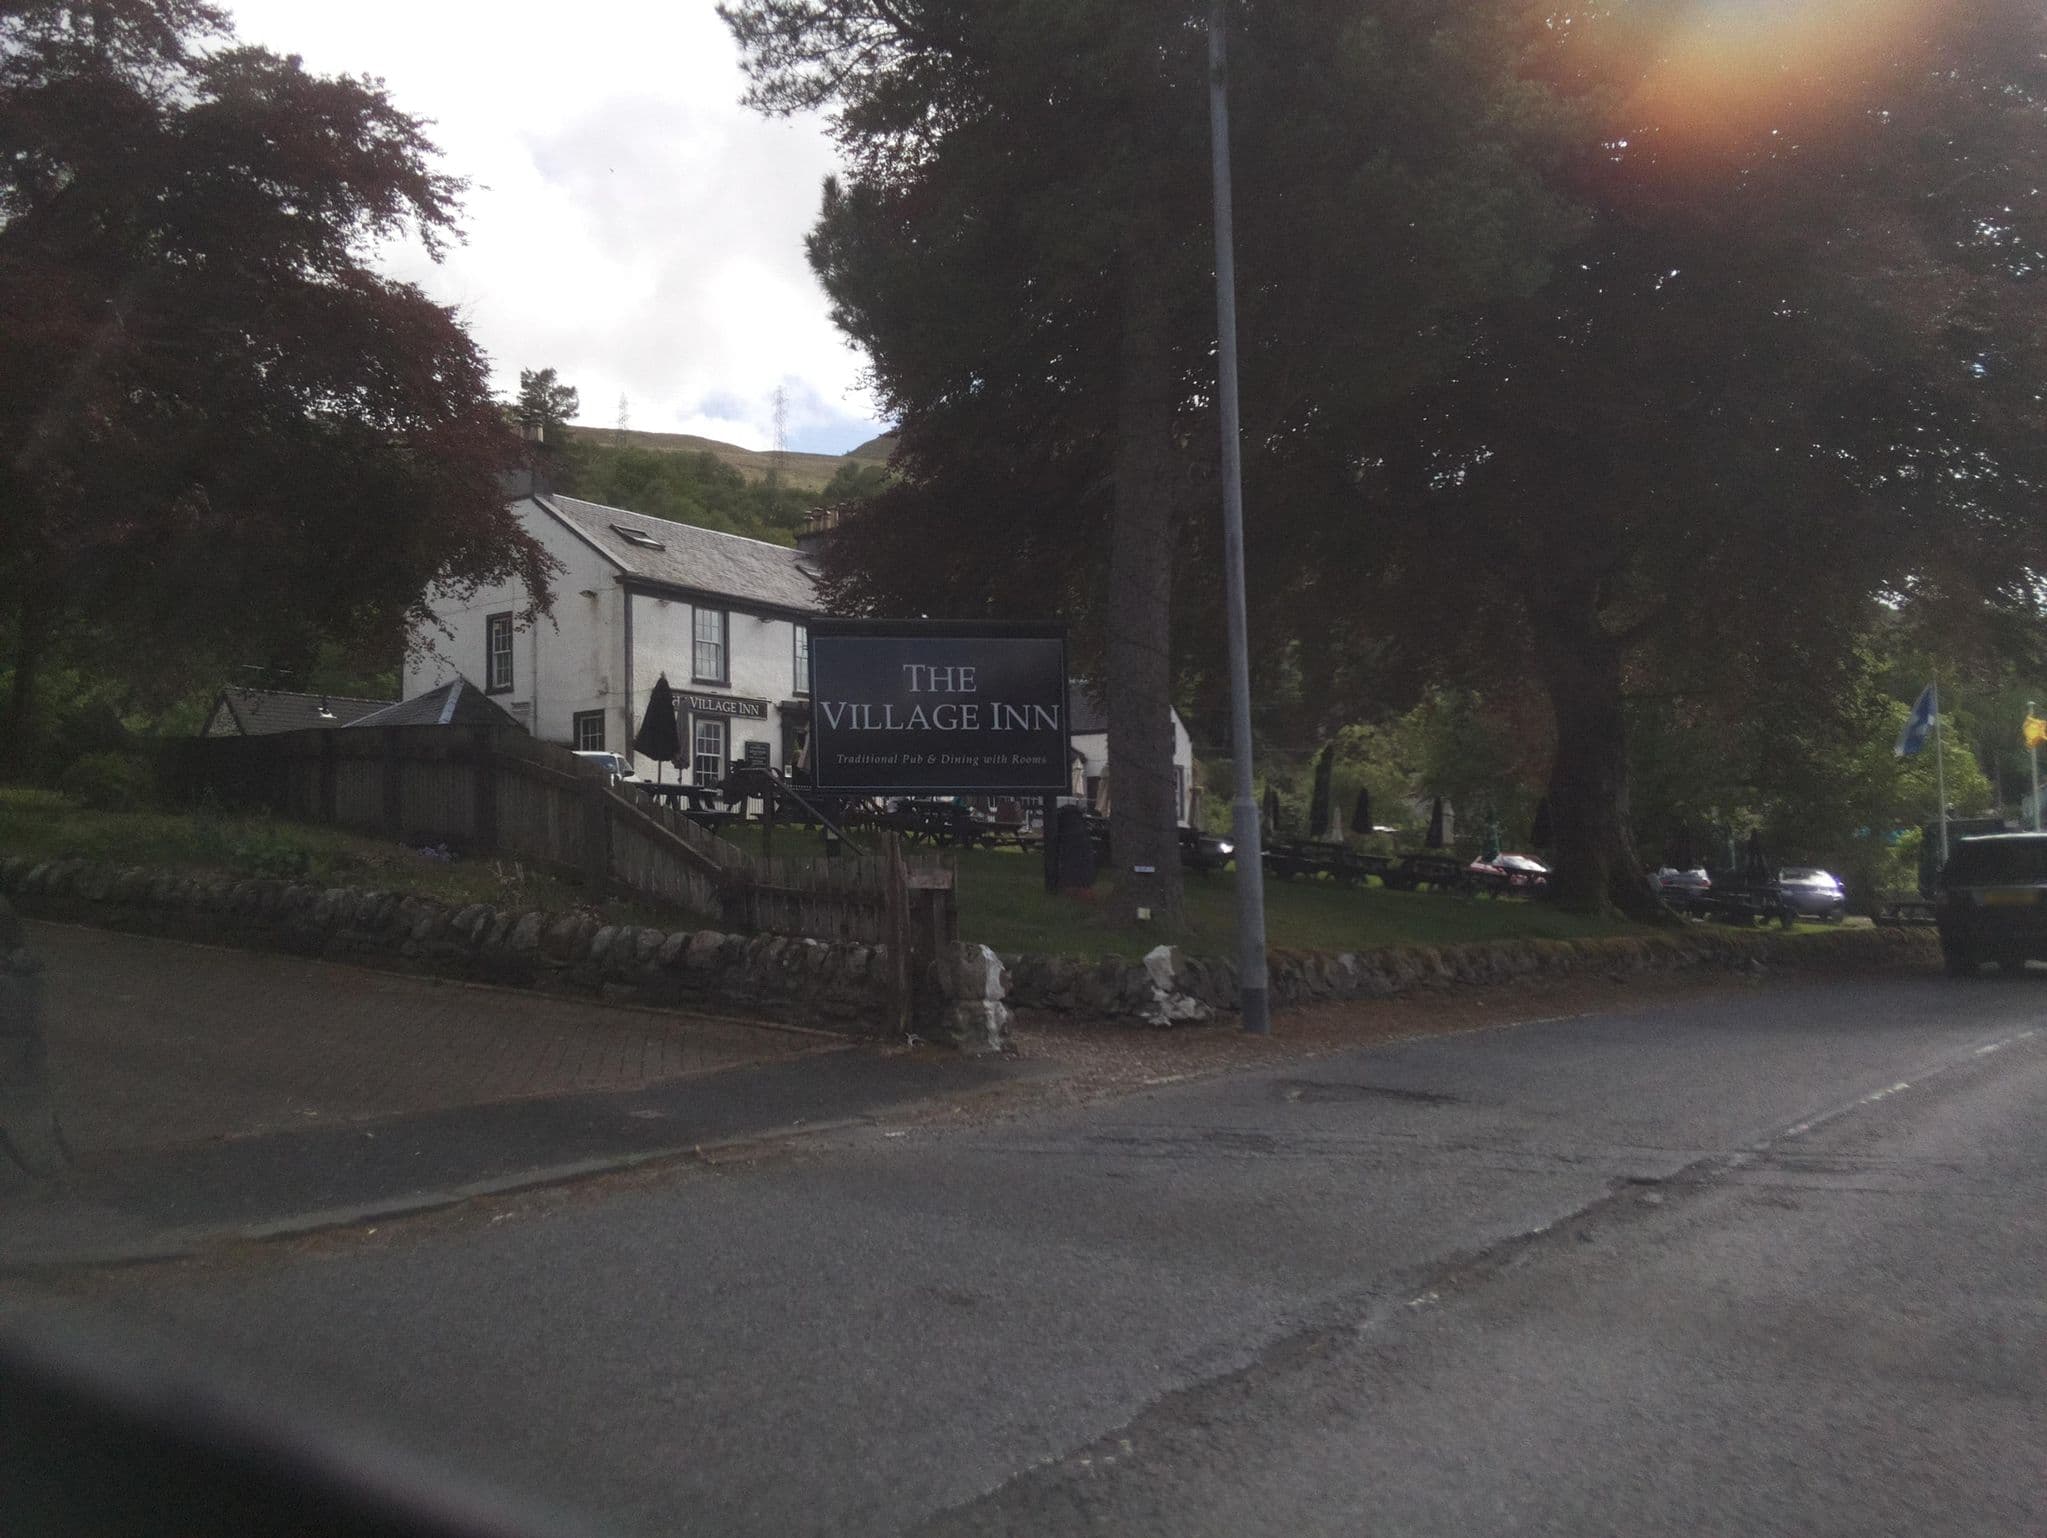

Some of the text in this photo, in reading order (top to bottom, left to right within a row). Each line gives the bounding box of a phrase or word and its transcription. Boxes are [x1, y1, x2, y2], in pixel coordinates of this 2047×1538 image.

[902, 664, 977, 693] THE
[689, 696, 737, 713] VILLAGE
[738, 702, 760, 716] INN
[819, 701, 1060, 731] VILLAGE INN
[836, 753, 1047, 767] Traditional Pub & Dining with Rooms
